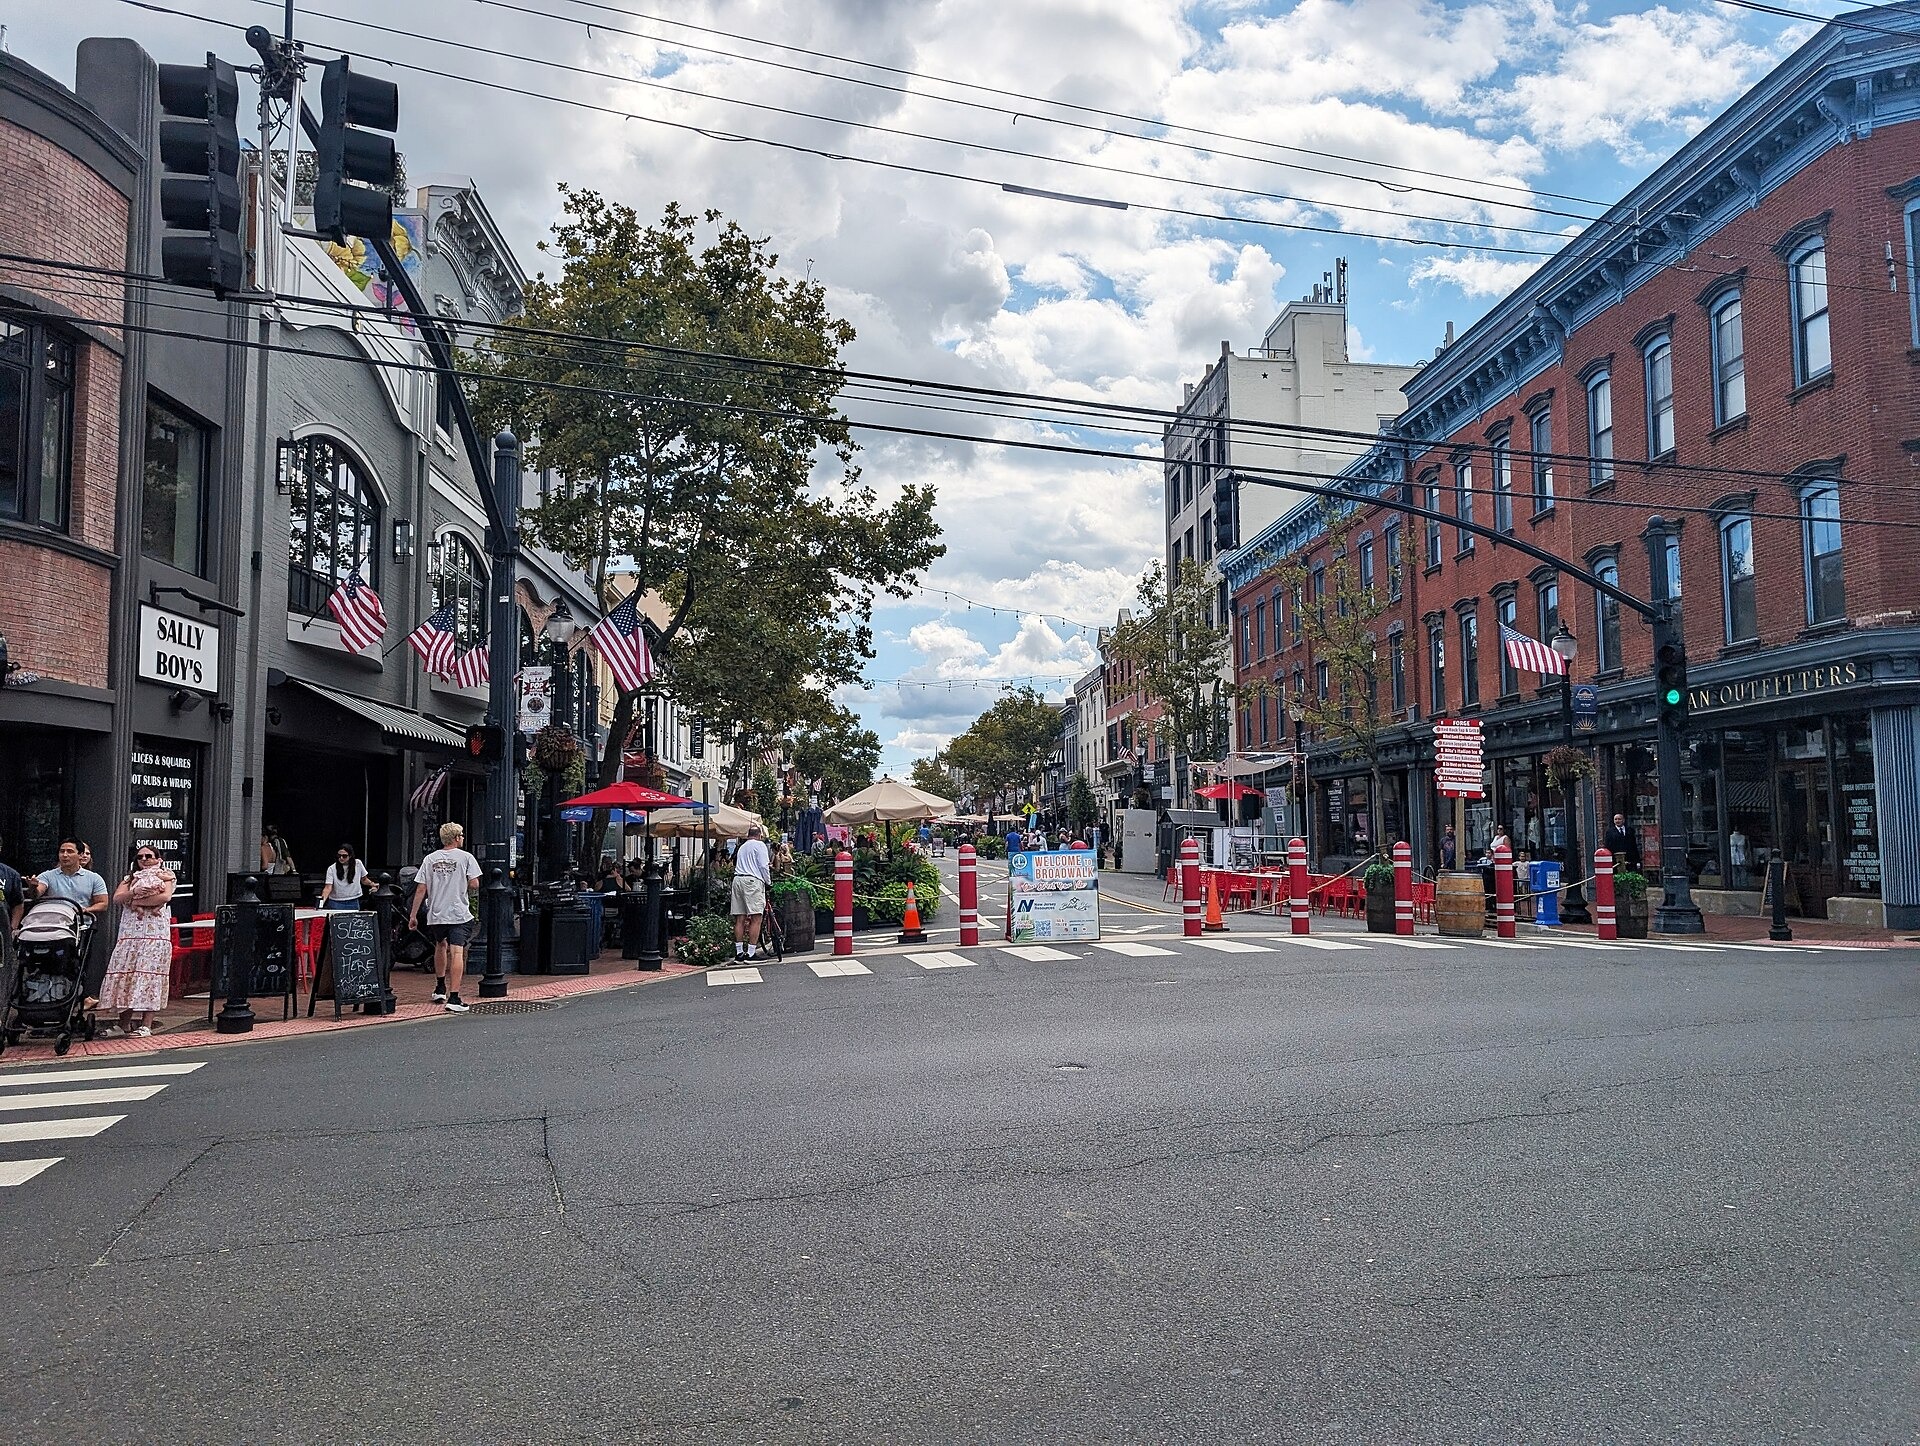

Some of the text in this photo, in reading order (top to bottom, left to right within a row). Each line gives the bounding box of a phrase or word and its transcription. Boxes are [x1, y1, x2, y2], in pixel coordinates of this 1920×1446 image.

[156, 615, 205, 651] SALLY
[155, 650, 203, 684] BOY'S
[1719, 662, 1857, 704] OUTFITTERS
[154, 755, 160, 766] &
[161, 755, 191, 769] SQUARES
[132, 773, 191, 789] OT SUBS & WRAPS
[146, 796, 172, 808] SALADS
[133, 817, 183, 829] FRIES & WINGS
[136, 839, 178, 850] SPECIALTIES
[162, 860, 182, 870] ATERY
[1034, 854, 1093, 867] WELCOME TO
[1035, 866, 1095, 879] BROADWALK
[336, 922, 373, 941] SLICES
